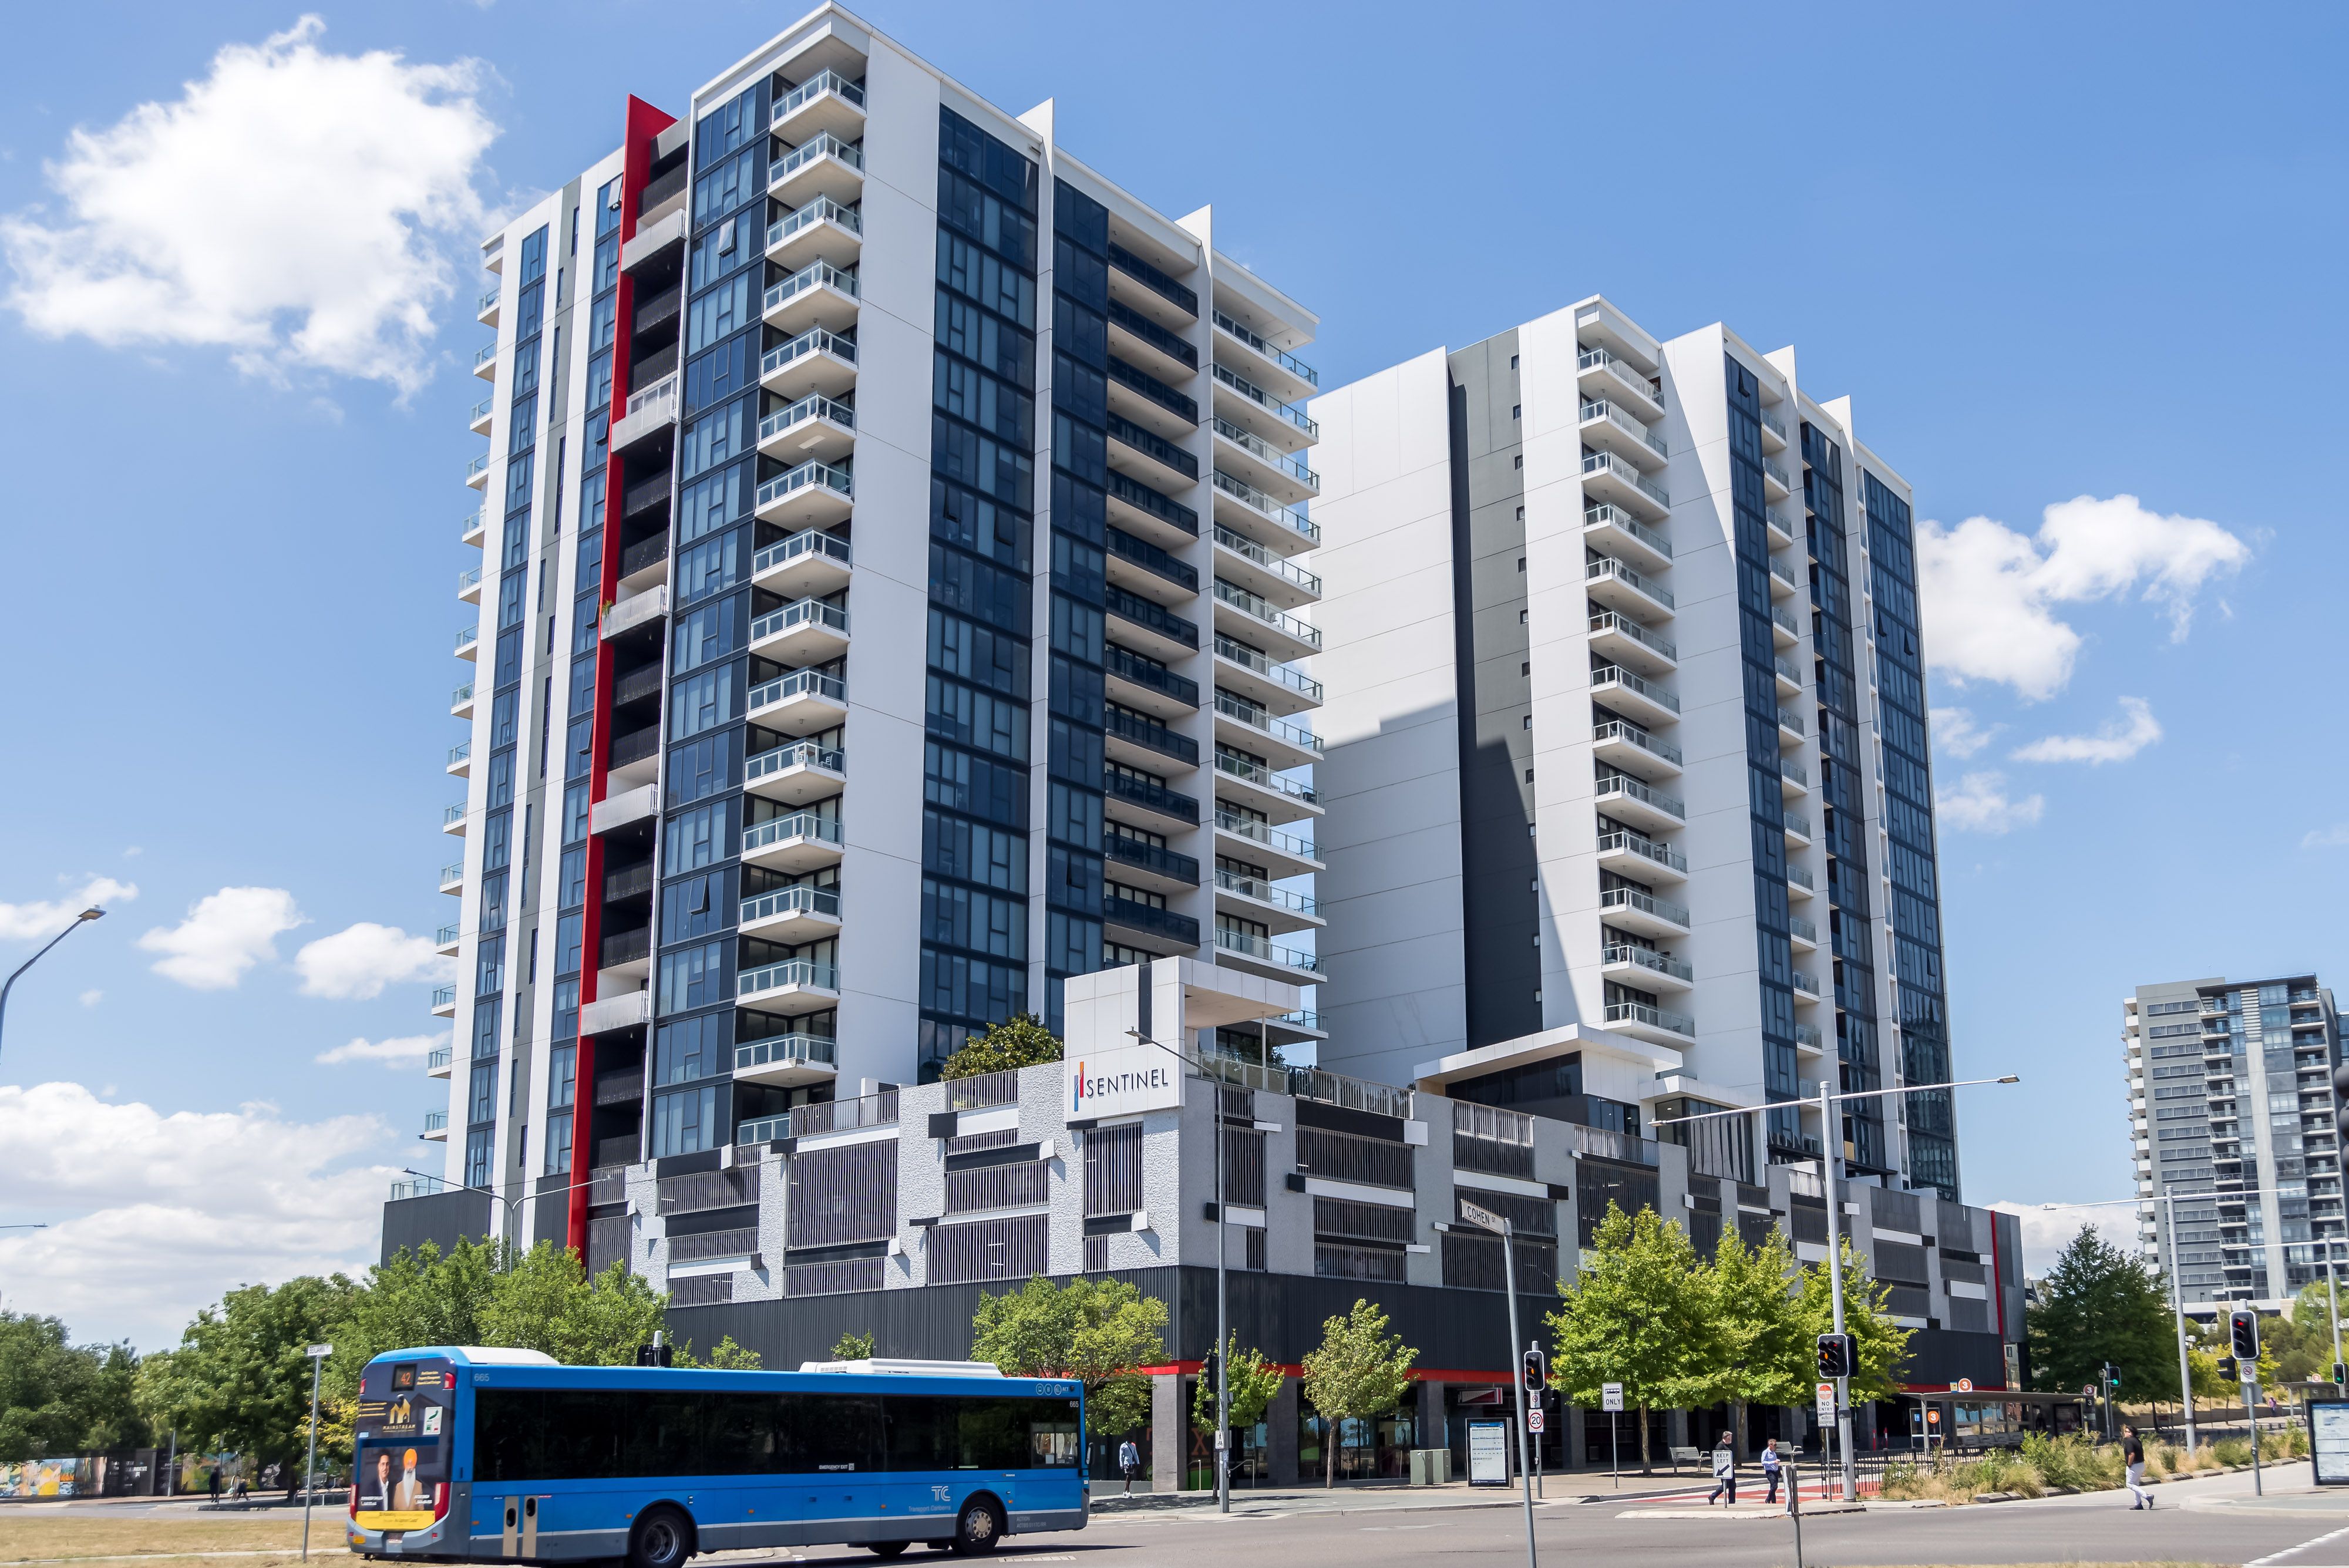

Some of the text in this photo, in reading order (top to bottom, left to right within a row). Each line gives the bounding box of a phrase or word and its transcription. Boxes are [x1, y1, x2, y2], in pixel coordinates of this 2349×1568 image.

[1086, 1068, 1169, 1097] SENTINEL
[1467, 1206, 1490, 1226] COHEN
[401, 1372, 412, 1385] 42
[474, 1373, 490, 1381] 665
[1961, 1381, 1968, 1389] 3
[1532, 1416, 1541, 1425] 20
[1930, 1413, 1936, 1421] 3
[931, 1485, 951, 1502] TC
